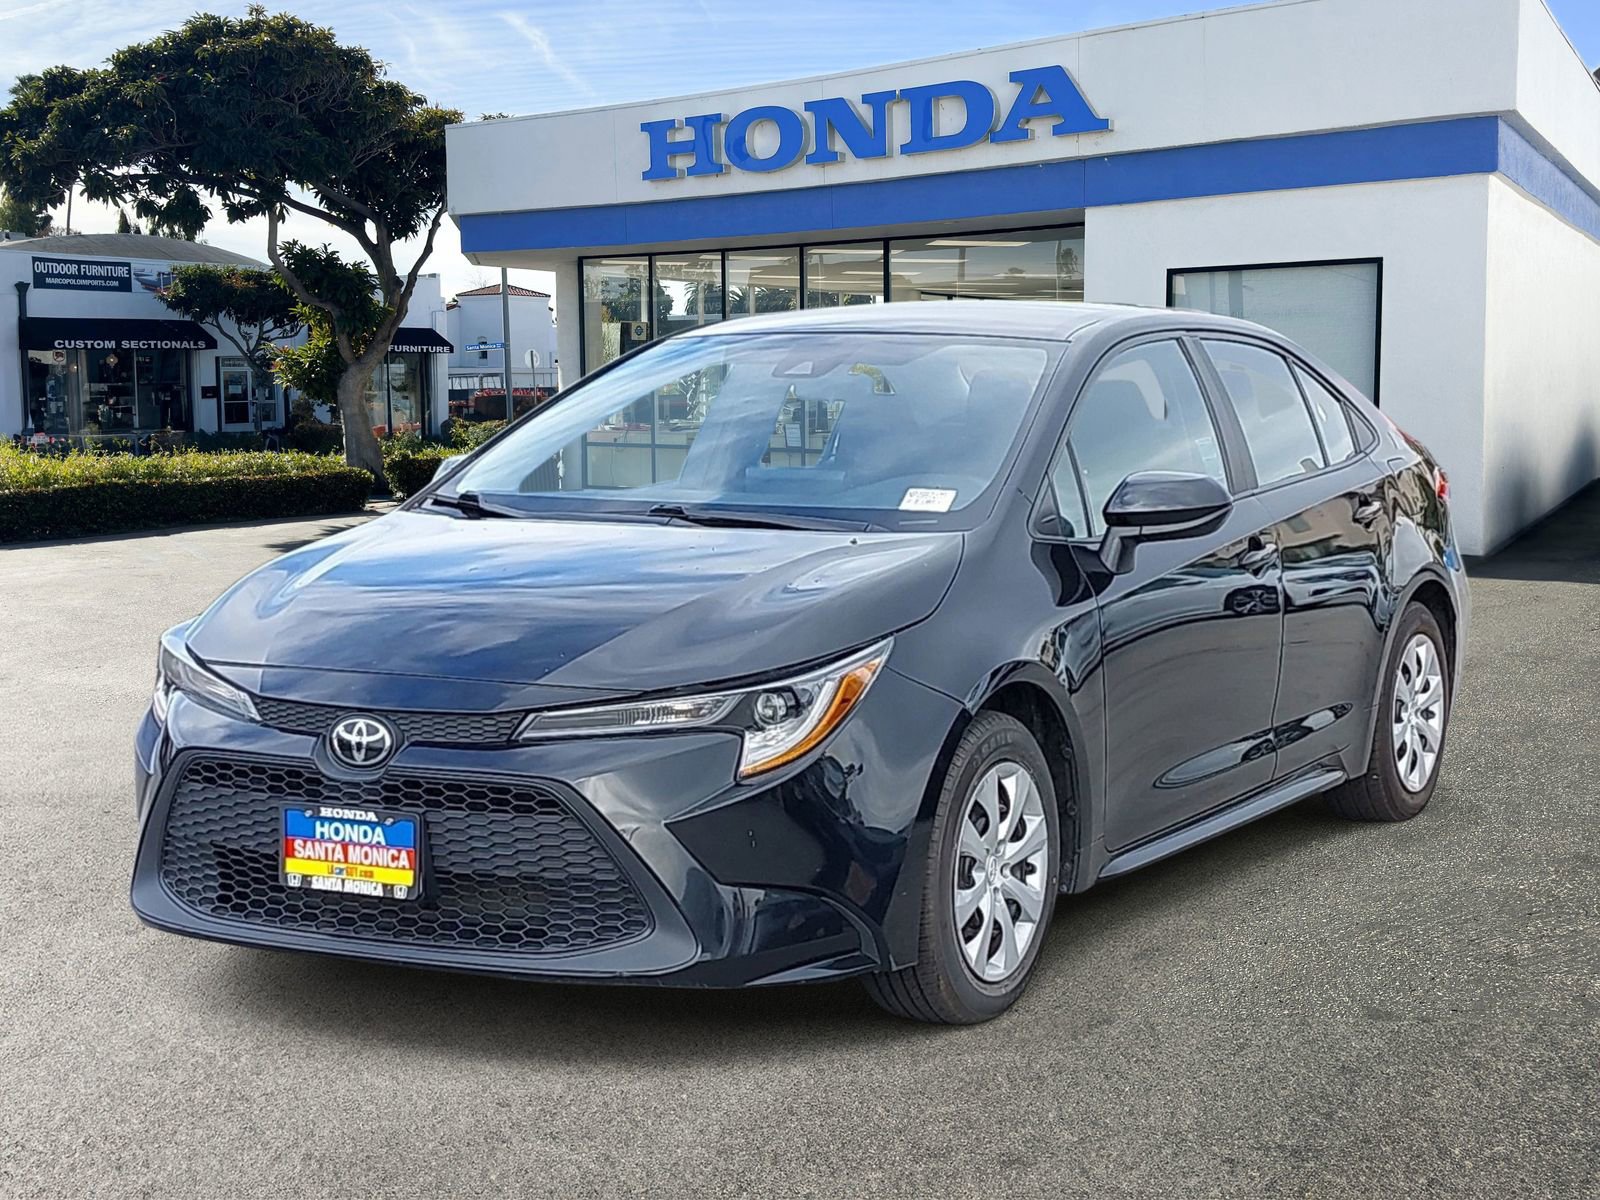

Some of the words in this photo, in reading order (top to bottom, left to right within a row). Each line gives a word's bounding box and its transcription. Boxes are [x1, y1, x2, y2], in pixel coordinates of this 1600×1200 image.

[640, 64, 1113, 182] HONDA
[34, 261, 79, 276] OUTDOOR
[80, 264, 130, 278] FURNITURE
[45, 277, 119, 287] MARCOPOLOIMPORTS.COM
[54, 339, 116, 349] CUSTOM
[121, 340, 206, 349] SECTIONALS
[388, 344, 451, 353] FURNITURE
[319, 807, 378, 822] HONDA
[315, 820, 387, 846] HONDA
[293, 839, 345, 863] SANTA
[347, 845, 410, 869] MONICA
[311, 876, 342, 892] SANTA
[343, 879, 384, 897] MONICA
